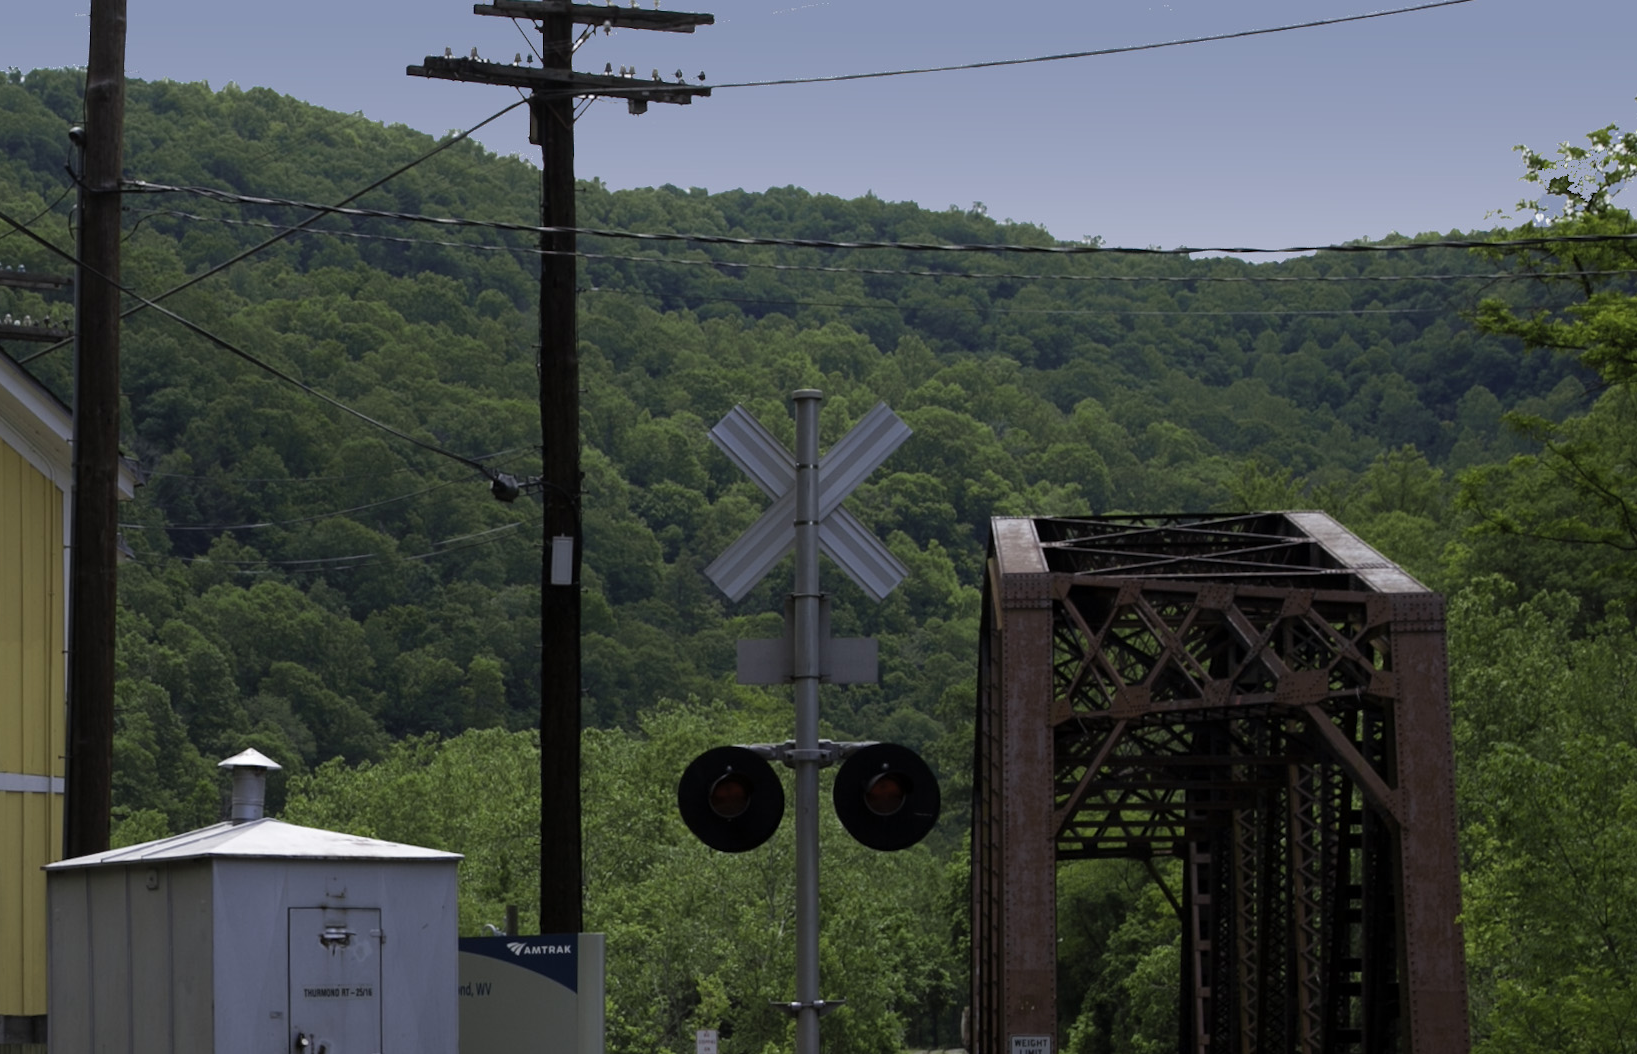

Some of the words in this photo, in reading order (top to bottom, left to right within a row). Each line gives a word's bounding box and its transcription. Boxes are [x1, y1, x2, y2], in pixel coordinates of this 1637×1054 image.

[524, 945, 571, 955] AMTRAK
[304, 988, 340, 997] THURMOND
[342, 988, 350, 996] RT
[476, 983, 491, 996] WV
[1014, 1039, 1048, 1047] WEIGHT
